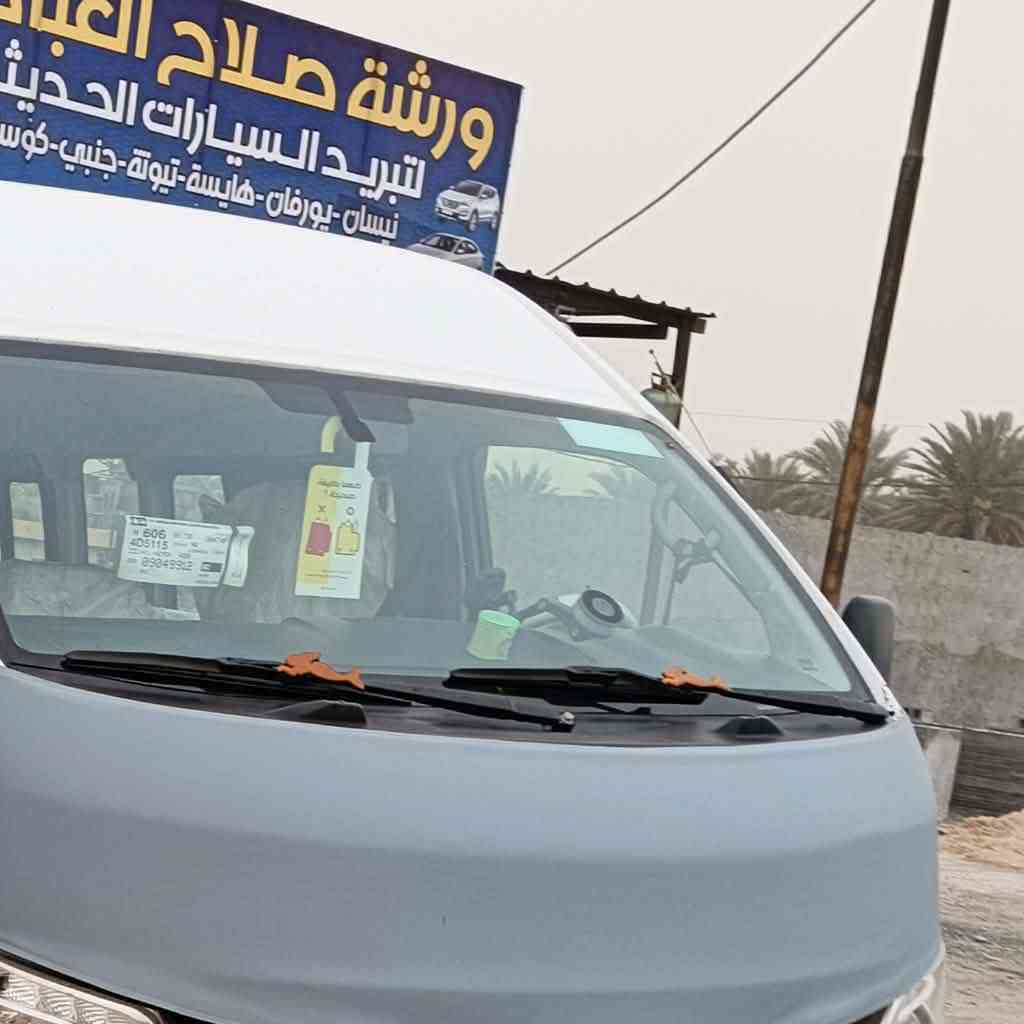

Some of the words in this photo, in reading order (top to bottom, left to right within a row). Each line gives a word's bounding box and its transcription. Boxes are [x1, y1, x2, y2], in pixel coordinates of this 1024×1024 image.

[157, 17, 337, 112] صلاح
[142, 97, 320, 172] السيارات
[347, 59, 495, 171] ورشة
[321, 146, 426, 205] لتبريد
